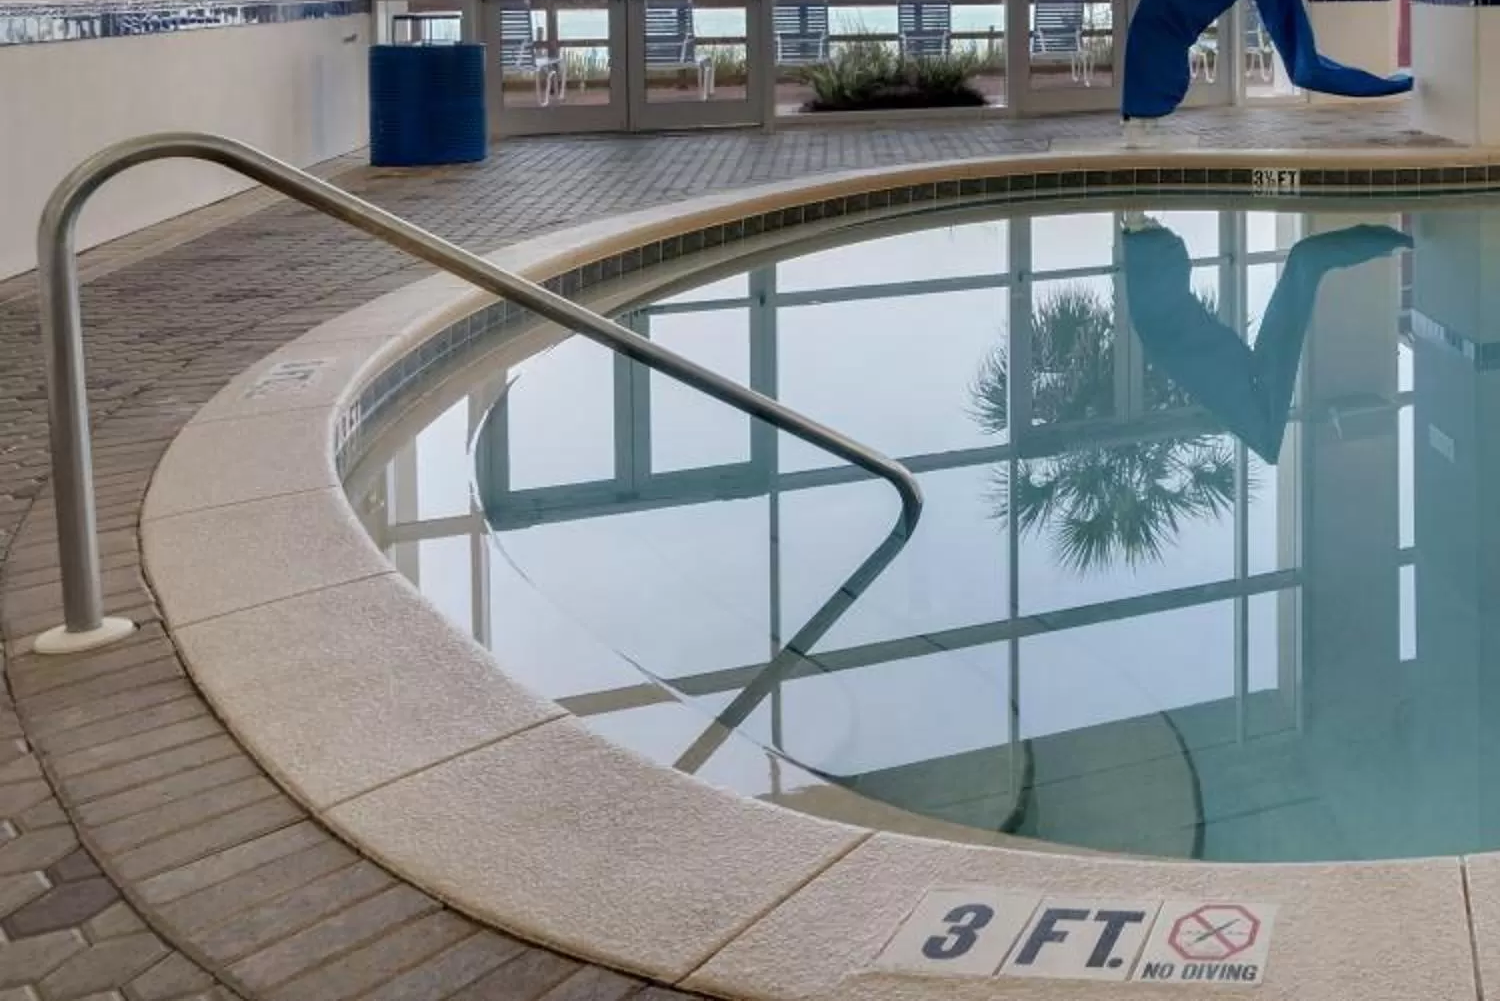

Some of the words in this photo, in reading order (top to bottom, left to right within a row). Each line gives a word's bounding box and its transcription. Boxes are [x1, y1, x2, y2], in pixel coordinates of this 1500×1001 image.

[1278, 170, 1298, 185] FT
[921, 903, 995, 960] 3
[1014, 908, 1146, 968] FT.
[1142, 961, 1175, 979] NO
[1181, 963, 1258, 981] DIVING
